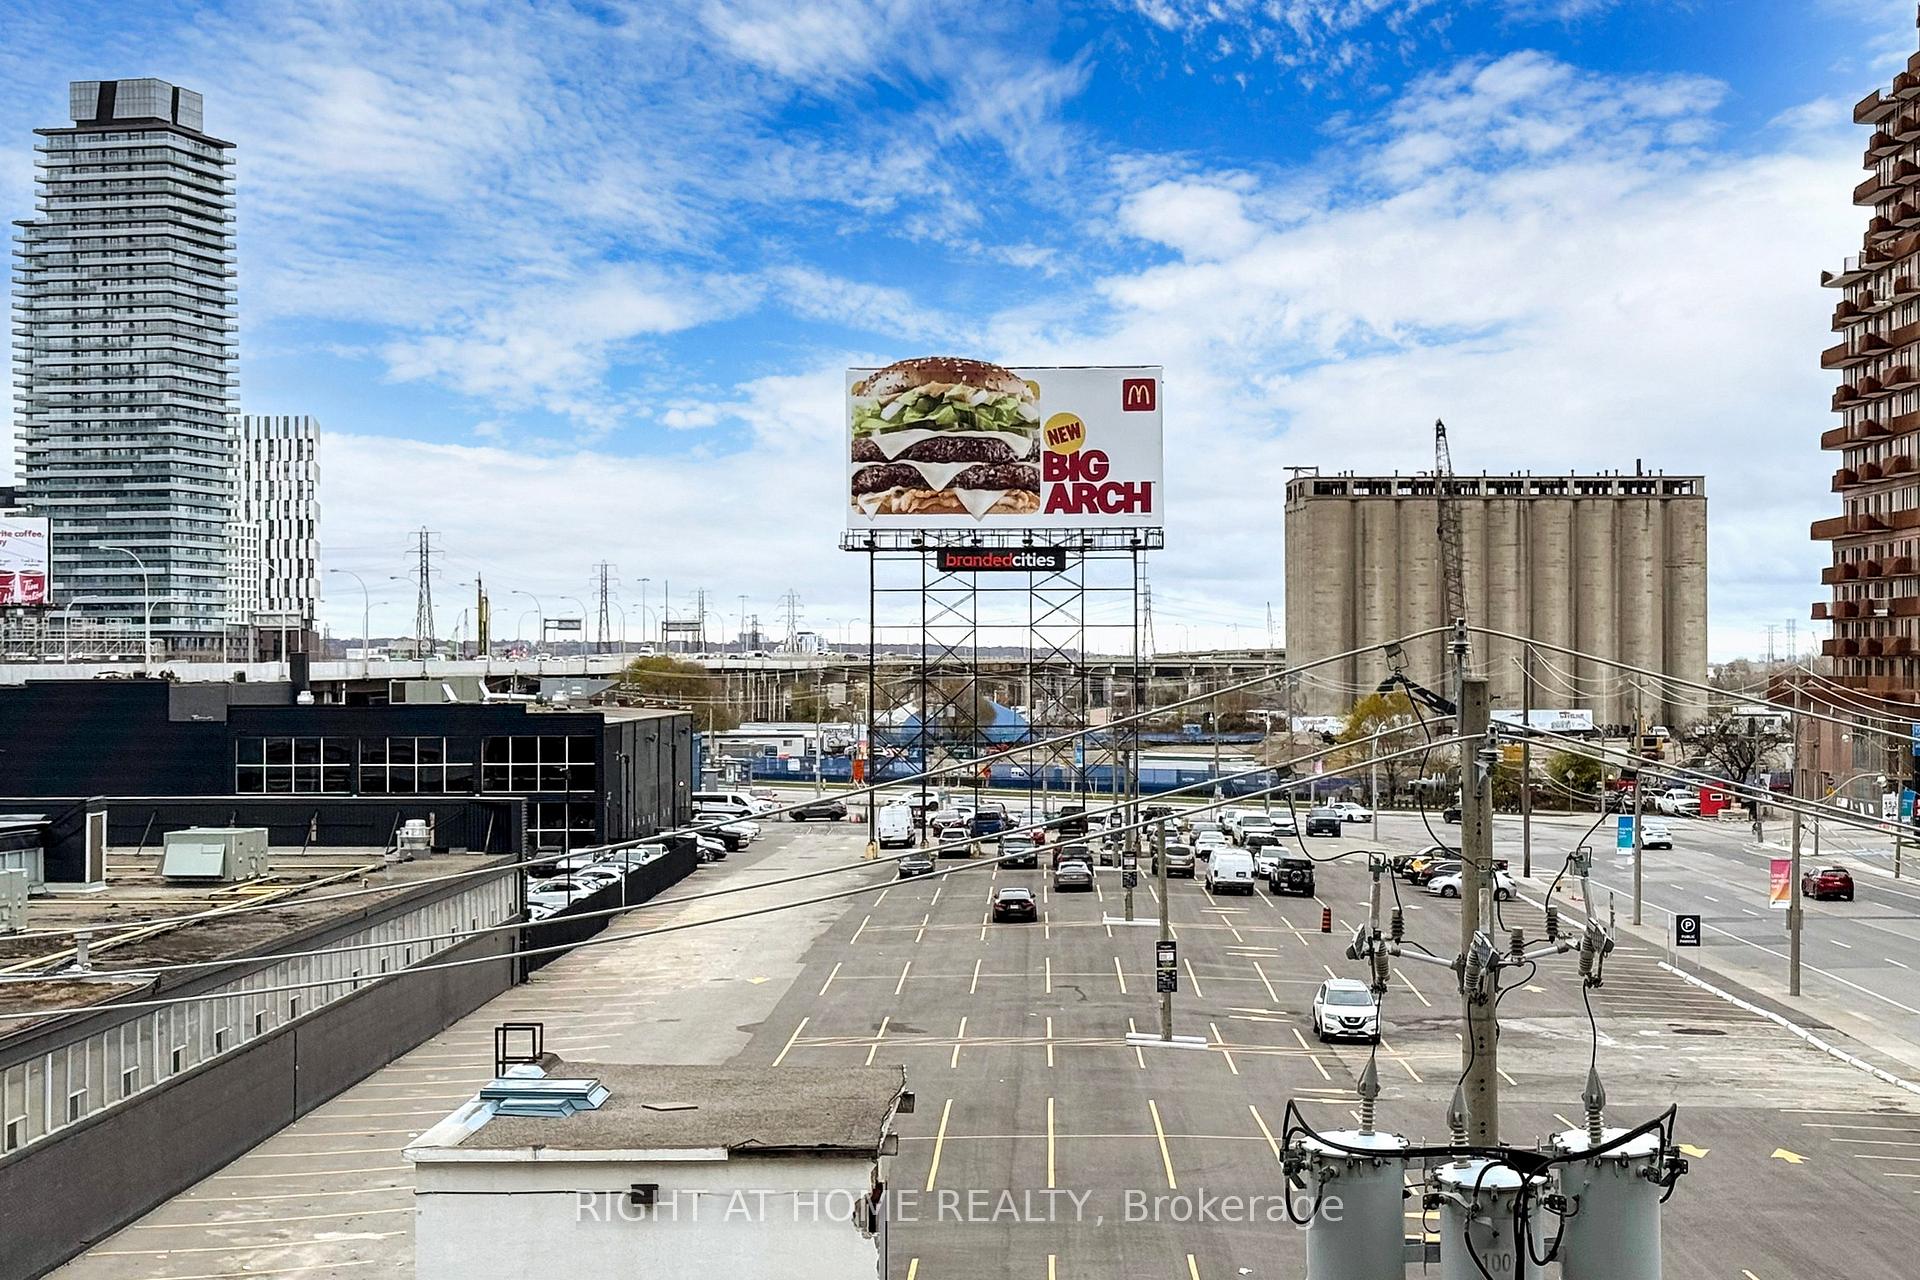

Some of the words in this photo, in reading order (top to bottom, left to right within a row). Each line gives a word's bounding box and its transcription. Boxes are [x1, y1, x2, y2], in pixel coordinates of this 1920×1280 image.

[1046, 421, 1082, 447] NEW
[1043, 449, 1110, 482] BIG
[1043, 481, 1152, 514] ARCH
[945, 552, 1056, 568] brandedcities
[1482, 1253, 1511, 1272] 100
